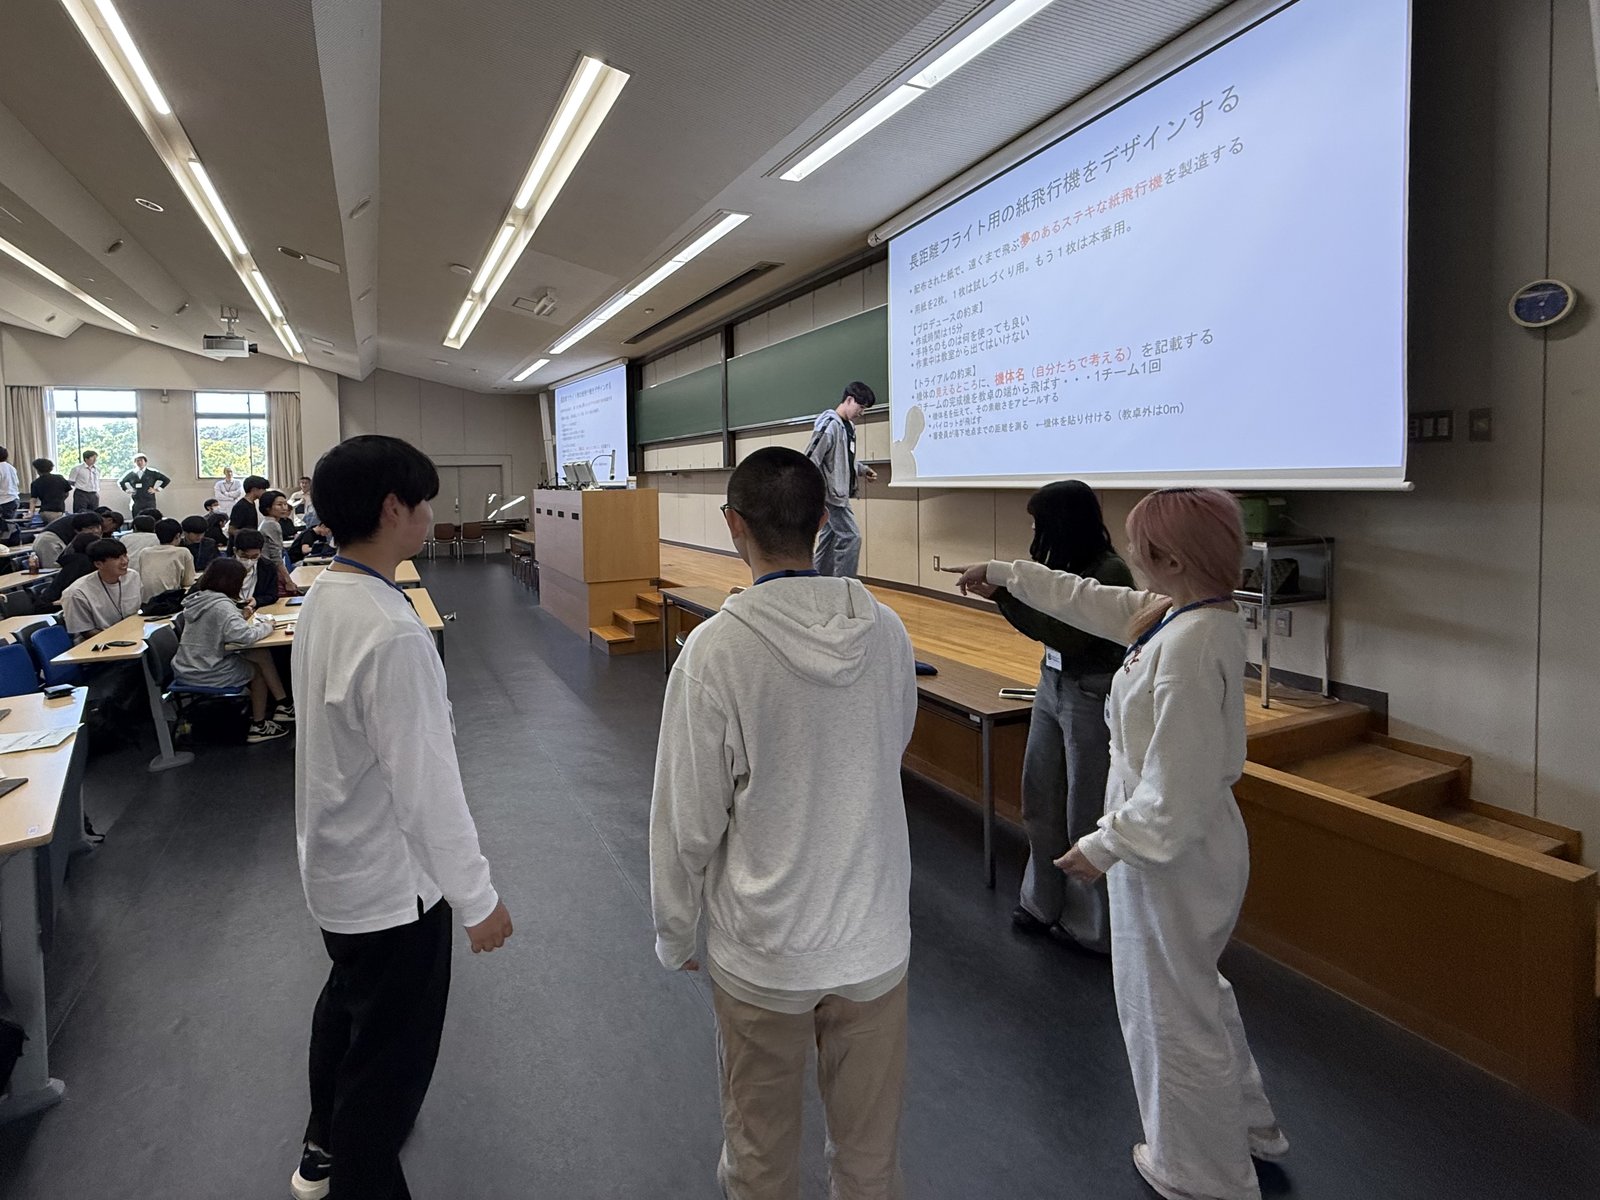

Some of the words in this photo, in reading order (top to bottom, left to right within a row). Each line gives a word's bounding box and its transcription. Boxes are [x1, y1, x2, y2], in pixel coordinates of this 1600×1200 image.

[909, 85, 1240, 271] 長距離フライト用の紙飛行機をデザインする
